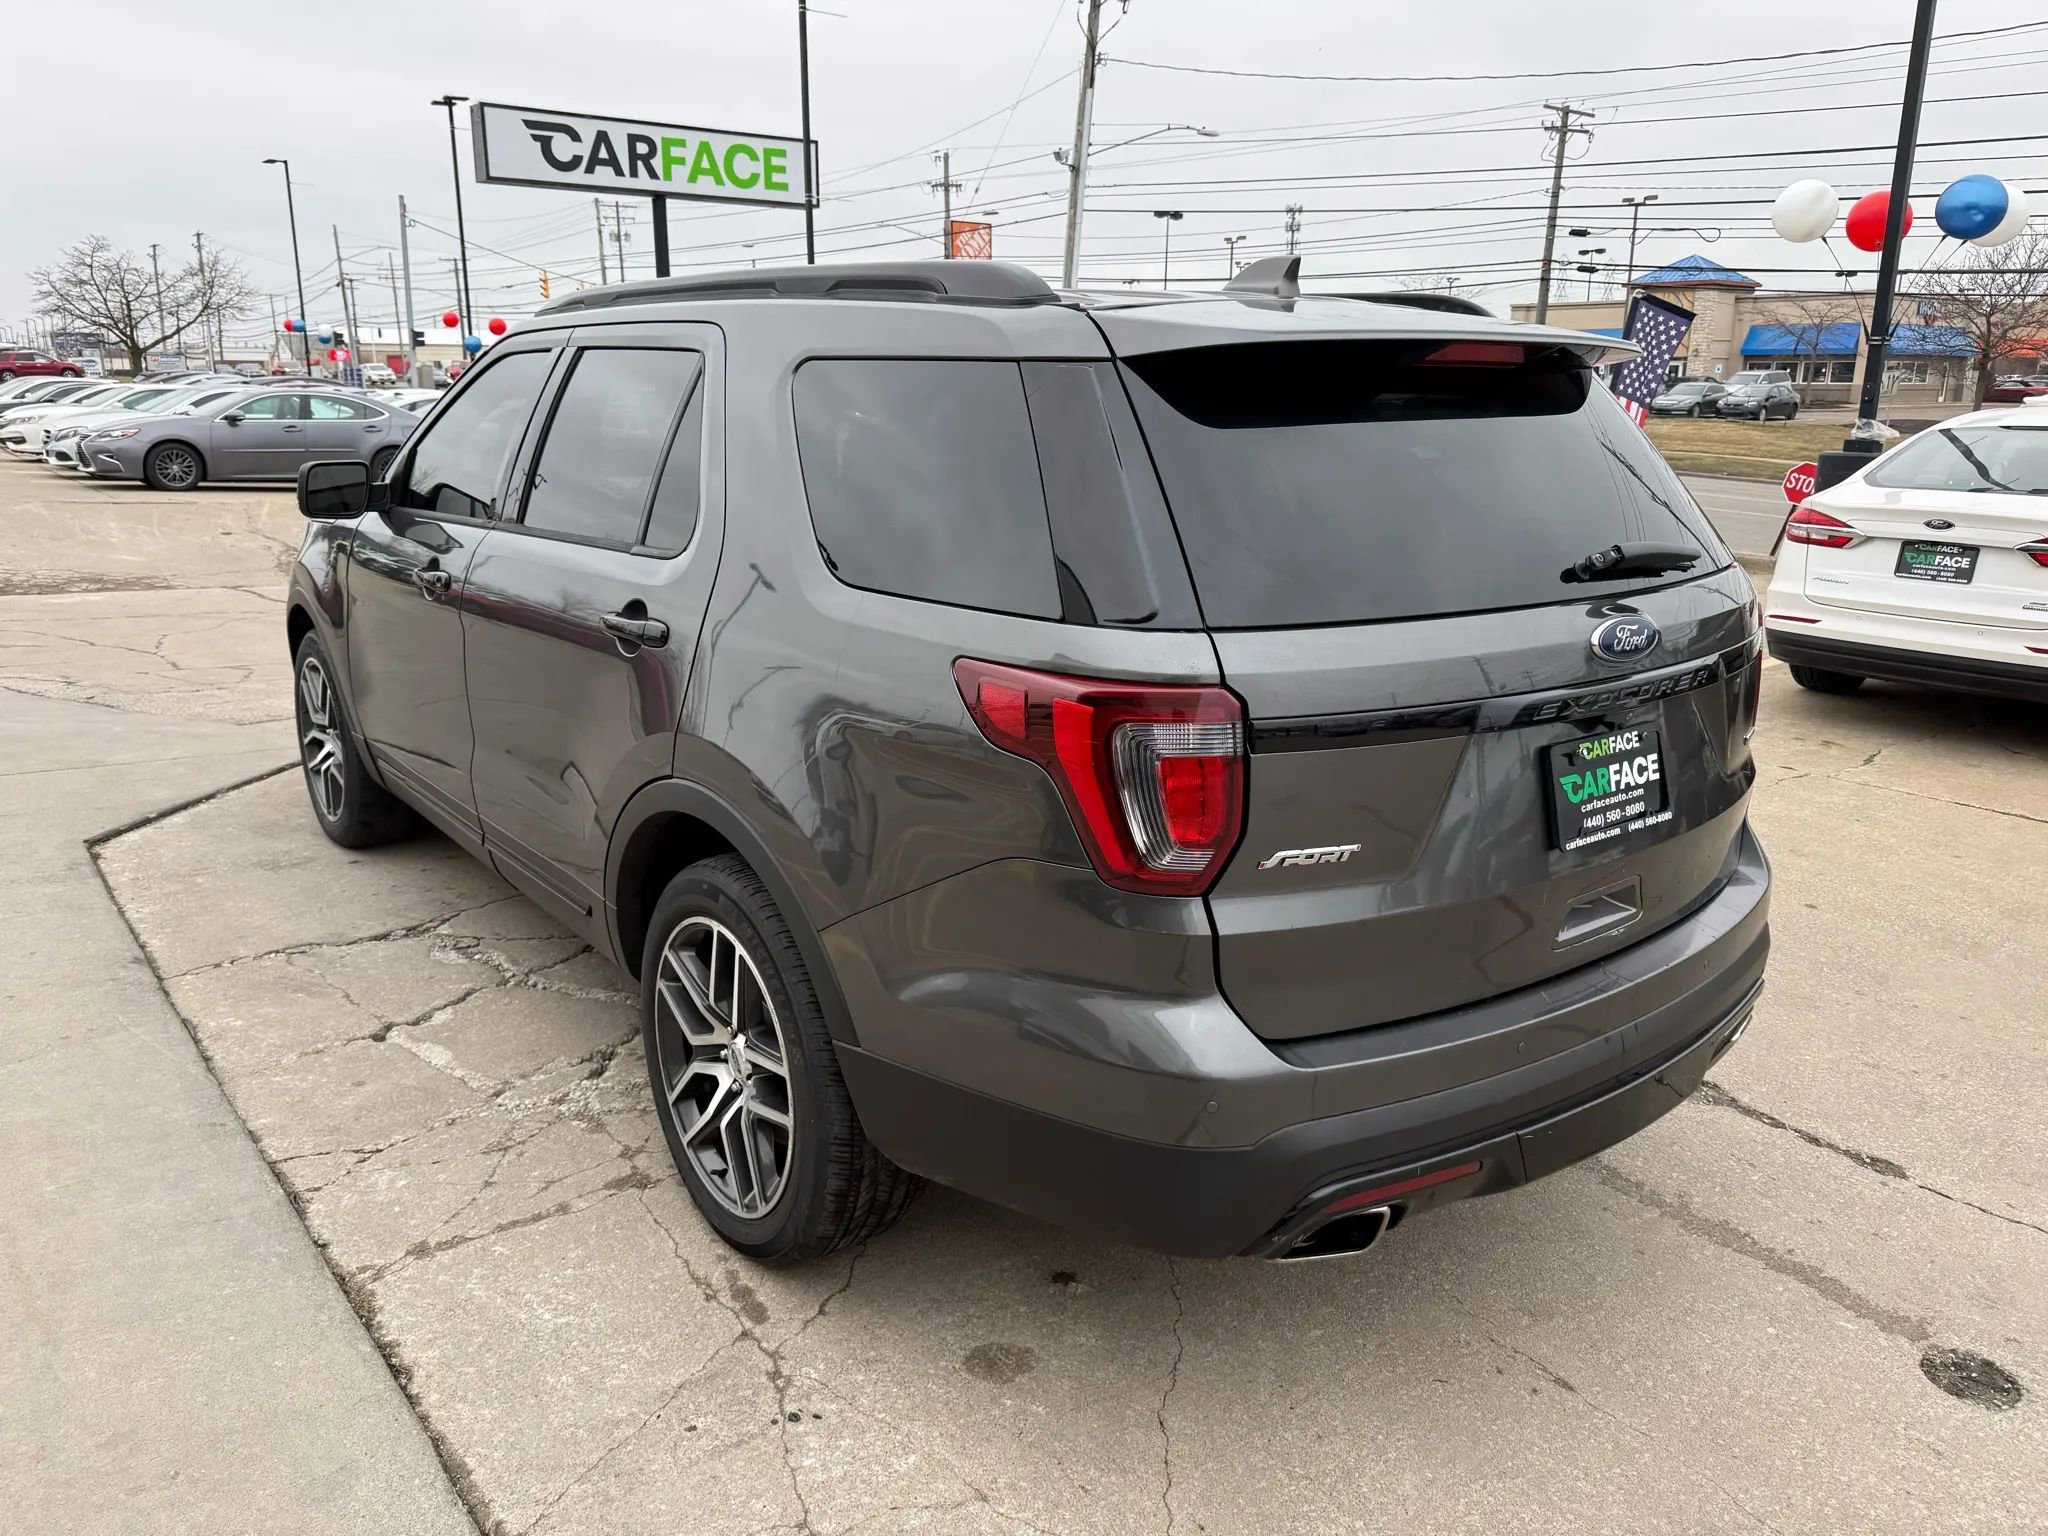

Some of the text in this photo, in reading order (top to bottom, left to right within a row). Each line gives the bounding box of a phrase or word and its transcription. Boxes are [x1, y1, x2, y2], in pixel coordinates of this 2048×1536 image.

[520, 118, 790, 192] CARFACE
[1786, 472, 1815, 494] STO
[1904, 552, 1971, 569] CARFACE
[1613, 624, 1648, 653] Ford
[1533, 670, 1709, 720] EXPLORER
[1579, 731, 1640, 760] CARFACE
[1559, 753, 1660, 804] CARFACE
[1581, 788, 1645, 812] carfaceauto.com
[1565, 827, 1621, 850] carfaceauto.com
[1628, 820, 1645, 832] (440)
[1583, 814, 1605, 828] (440)
[1258, 844, 1362, 869] SPORT
